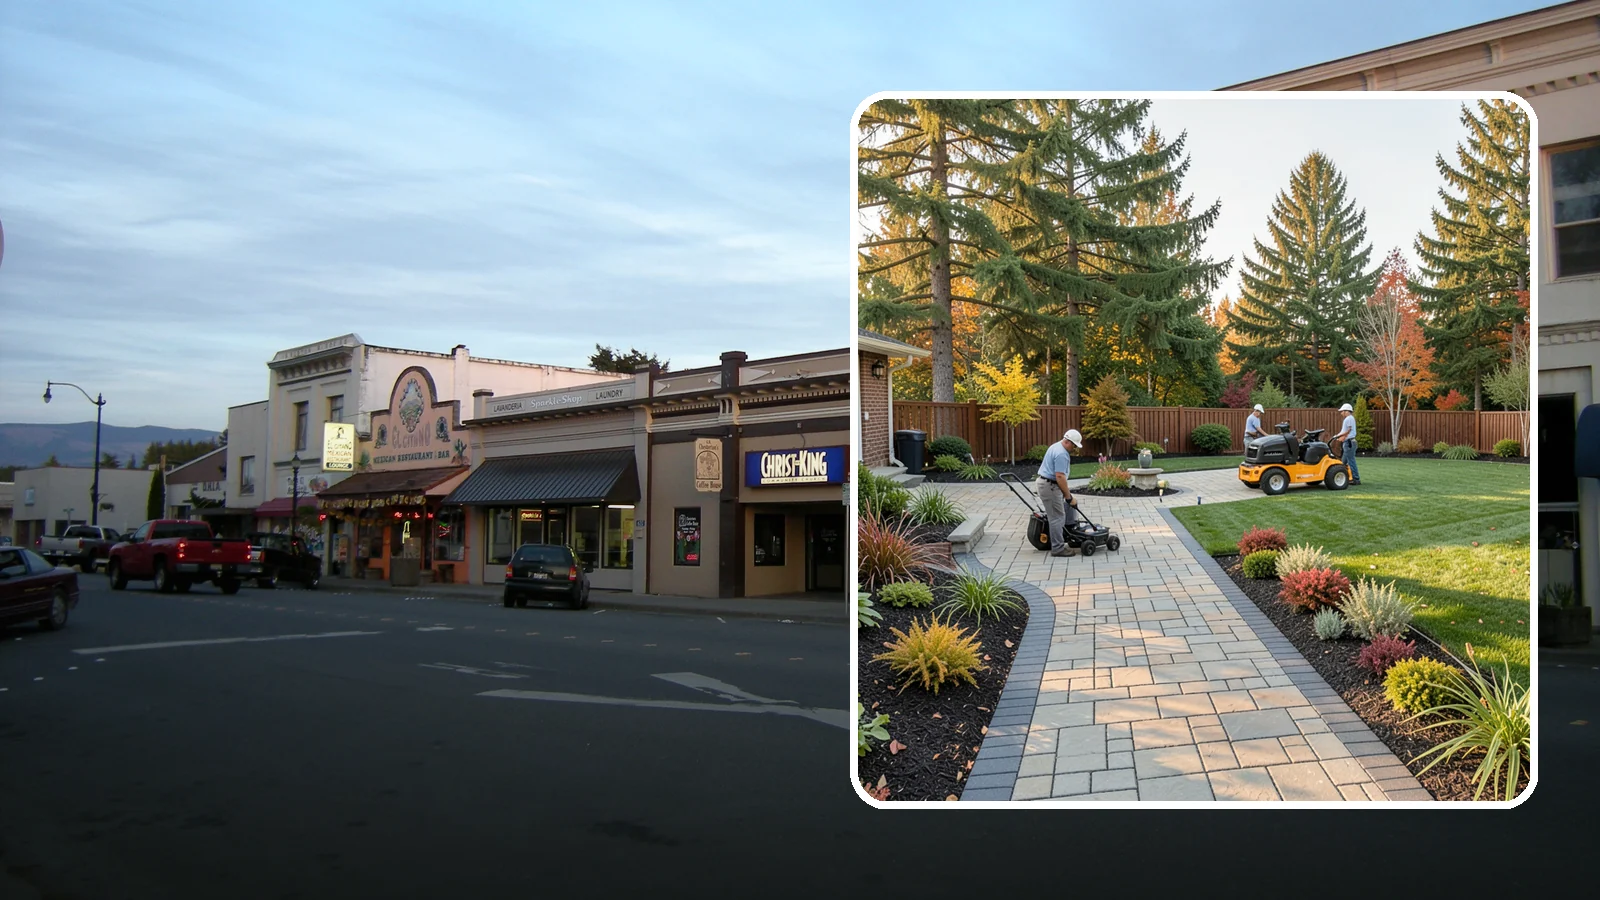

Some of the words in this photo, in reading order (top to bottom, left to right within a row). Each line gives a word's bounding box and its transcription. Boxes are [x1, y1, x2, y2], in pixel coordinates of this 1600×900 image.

[595, 388, 624, 400] LAUNDRY
[493, 401, 523, 413] LAVANDERIA
[530, 397, 562, 409] Sparkle
[562, 394, 582, 404] Shop
[373, 454, 396, 464] MEXICAN
[397, 451, 433, 462] RESTAURANT
[438, 450, 450, 459] BAR
[760, 452, 797, 478] CHRIST
[799, 449, 827, 477] KING
